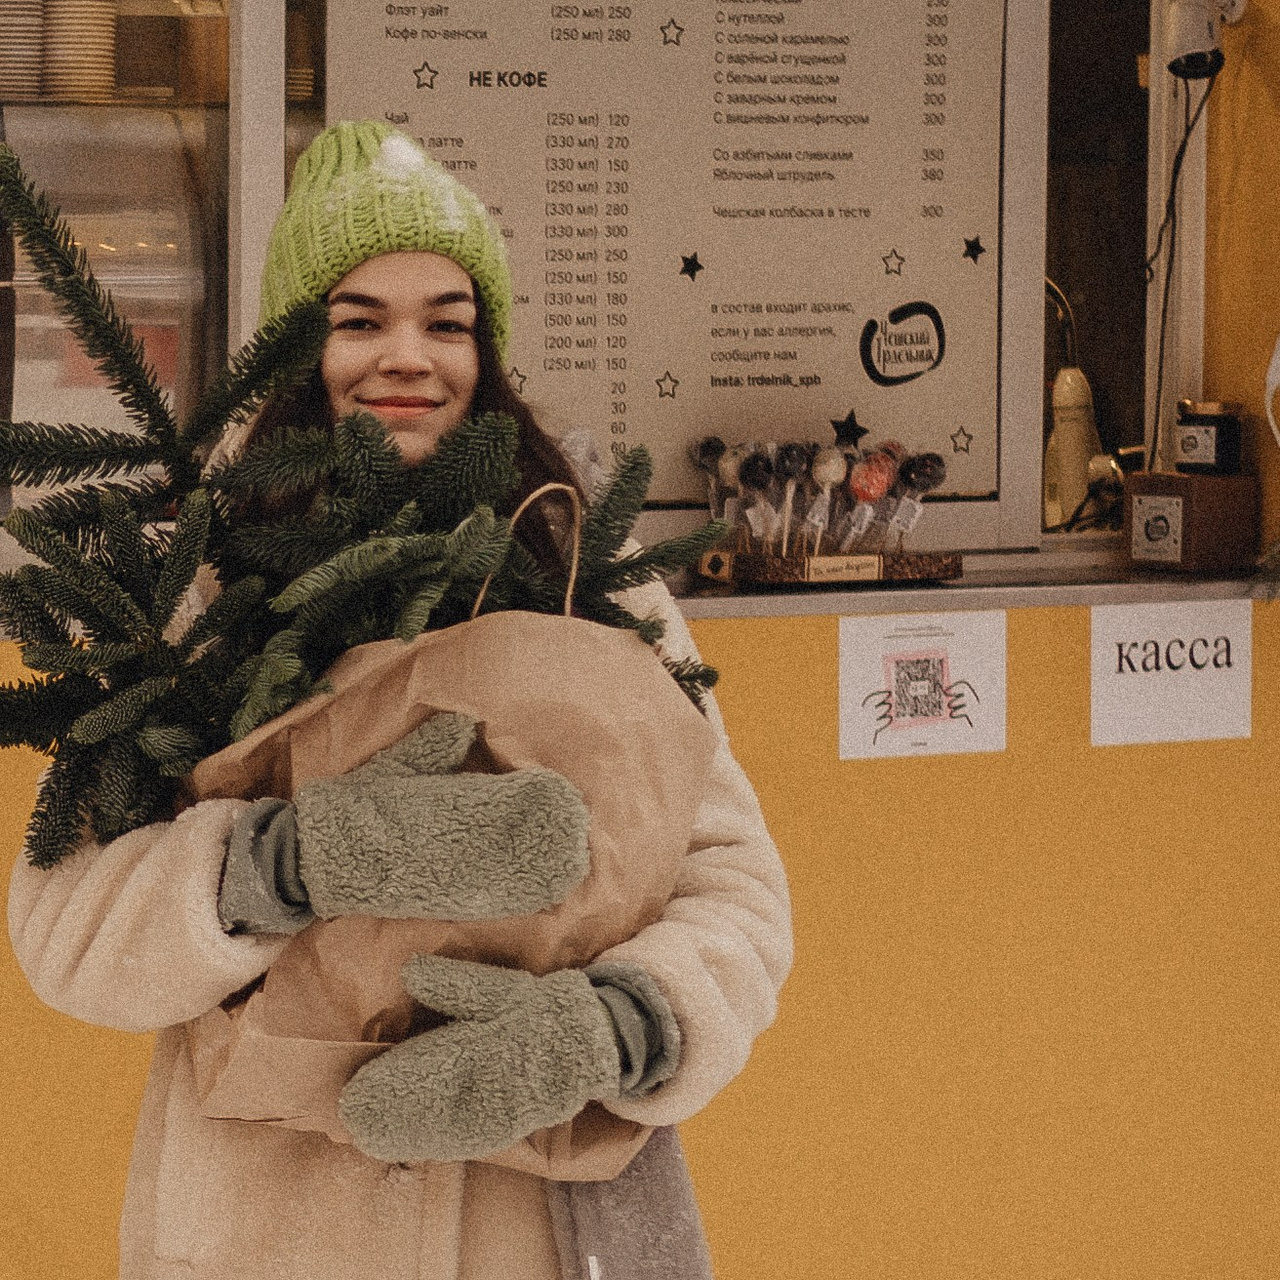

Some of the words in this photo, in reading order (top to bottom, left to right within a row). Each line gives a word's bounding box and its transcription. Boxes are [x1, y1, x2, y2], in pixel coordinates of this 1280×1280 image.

[385, 4, 417, 17] Флэт
[421, 5, 449, 19] уайт
[582, 7, 604, 20] мл)
[608, 6, 631, 19] 250
[715, 11, 725, 23] С
[728, 13, 784, 27] нутеллой
[385, 26, 418, 42] Кофе
[420, 29, 488, 40] по-венски
[550, 28, 578, 41] (250
[581, 29, 603, 42] мл)
[714, 32, 725, 44] С
[714, 51, 724, 64] С
[469, 71, 492, 87] НЕ
[497, 71, 548, 87] КОФЕ
[714, 71, 724, 84] С
[726, 71, 767, 84] белым
[771, 73, 840, 86] шоколадом
[713, 91, 723, 104] С
[726, 93, 787, 106] заварным
[789, 93, 837, 106] кремом
[384, 111, 409, 125] Чай
[546, 113, 575, 126] (250
[577, 114, 599, 126] мл)
[607, 114, 630, 126] 120
[713, 111, 723, 124] С
[427, 136, 464, 148] латте
[545, 135, 574, 149] (330
[577, 137, 599, 149] мл)
[606, 136, 630, 149] 270
[713, 148, 730, 161] Со
[732, 148, 792, 161] взбитыми
[795, 150, 854, 162] сливками
[545, 158, 574, 171] (330
[577, 159, 599, 172] мл)
[607, 160, 629, 172] 150
[712, 167, 774, 182] Яблочный
[777, 170, 835, 184] штрудель
[545, 181, 574, 194] (250
[577, 182, 599, 194] мл)
[545, 203, 574, 217] (330
[576, 204, 599, 217] мл)
[712, 206, 766, 218] Чешская
[768, 206, 824, 218] колбаска
[827, 208, 835, 218] в
[838, 208, 871, 218] тесте
[544, 225, 573, 239] (330
[576, 226, 598, 239] мл)
[604, 225, 628, 238] 300
[545, 248, 573, 262] (250
[576, 249, 598, 262] мл)
[604, 249, 628, 262] 250
[545, 271, 573, 285] (250
[576, 272, 598, 285] мл)
[606, 272, 628, 284] 150
[544, 292, 572, 306] (330
[575, 294, 597, 306] мл)
[711, 305, 718, 314] в
[721, 304, 763, 314] состав
[766, 303, 808, 315] входит
[544, 314, 572, 327] (500
[575, 315, 597, 327] мл)
[606, 314, 627, 327] 150
[711, 327, 740, 338] если
[742, 328, 750, 340] у
[753, 326, 774, 338] вас
[544, 336, 572, 349] (200
[575, 337, 597, 349] мл)
[606, 336, 627, 349] 120
[543, 358, 571, 371] (250
[575, 359, 596, 371] мл)
[605, 358, 627, 370] 150
[710, 350, 770, 365] сообщите
[773, 351, 798, 362] нам
[610, 381, 626, 394] 20
[610, 402, 626, 414] 30
[1115, 635, 1234, 674] касса
